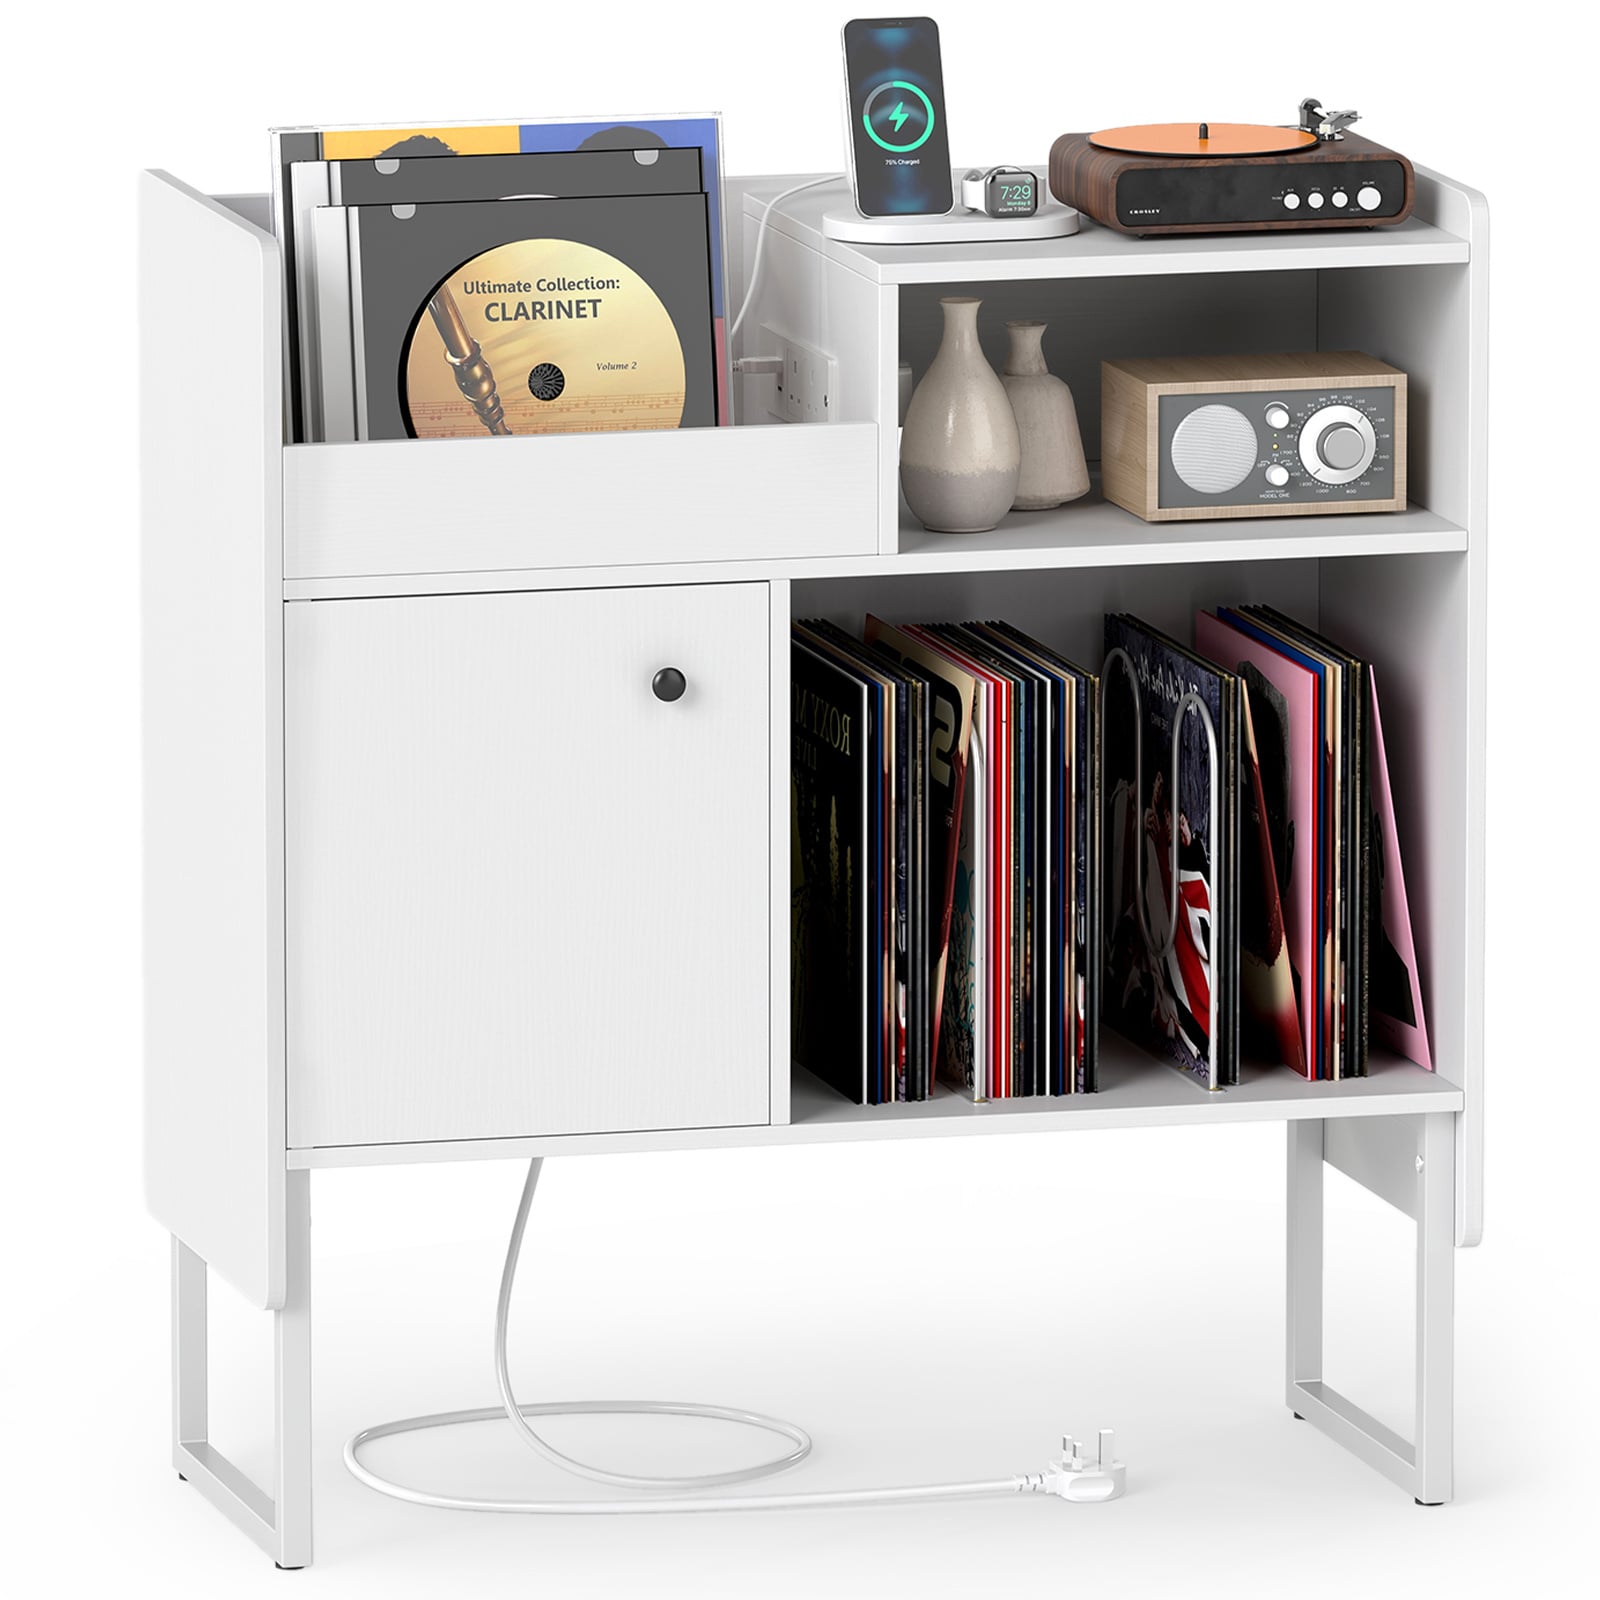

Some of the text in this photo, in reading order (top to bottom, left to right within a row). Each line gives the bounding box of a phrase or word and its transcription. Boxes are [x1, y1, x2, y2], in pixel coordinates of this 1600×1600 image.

[897, 158, 920, 166] Charged
[1000, 185, 1032, 200] 7:29
[463, 277, 620, 295] Ultimate Collection:
[484, 298, 602, 322] CLARINET
[596, 361, 638, 372] Volume 2
